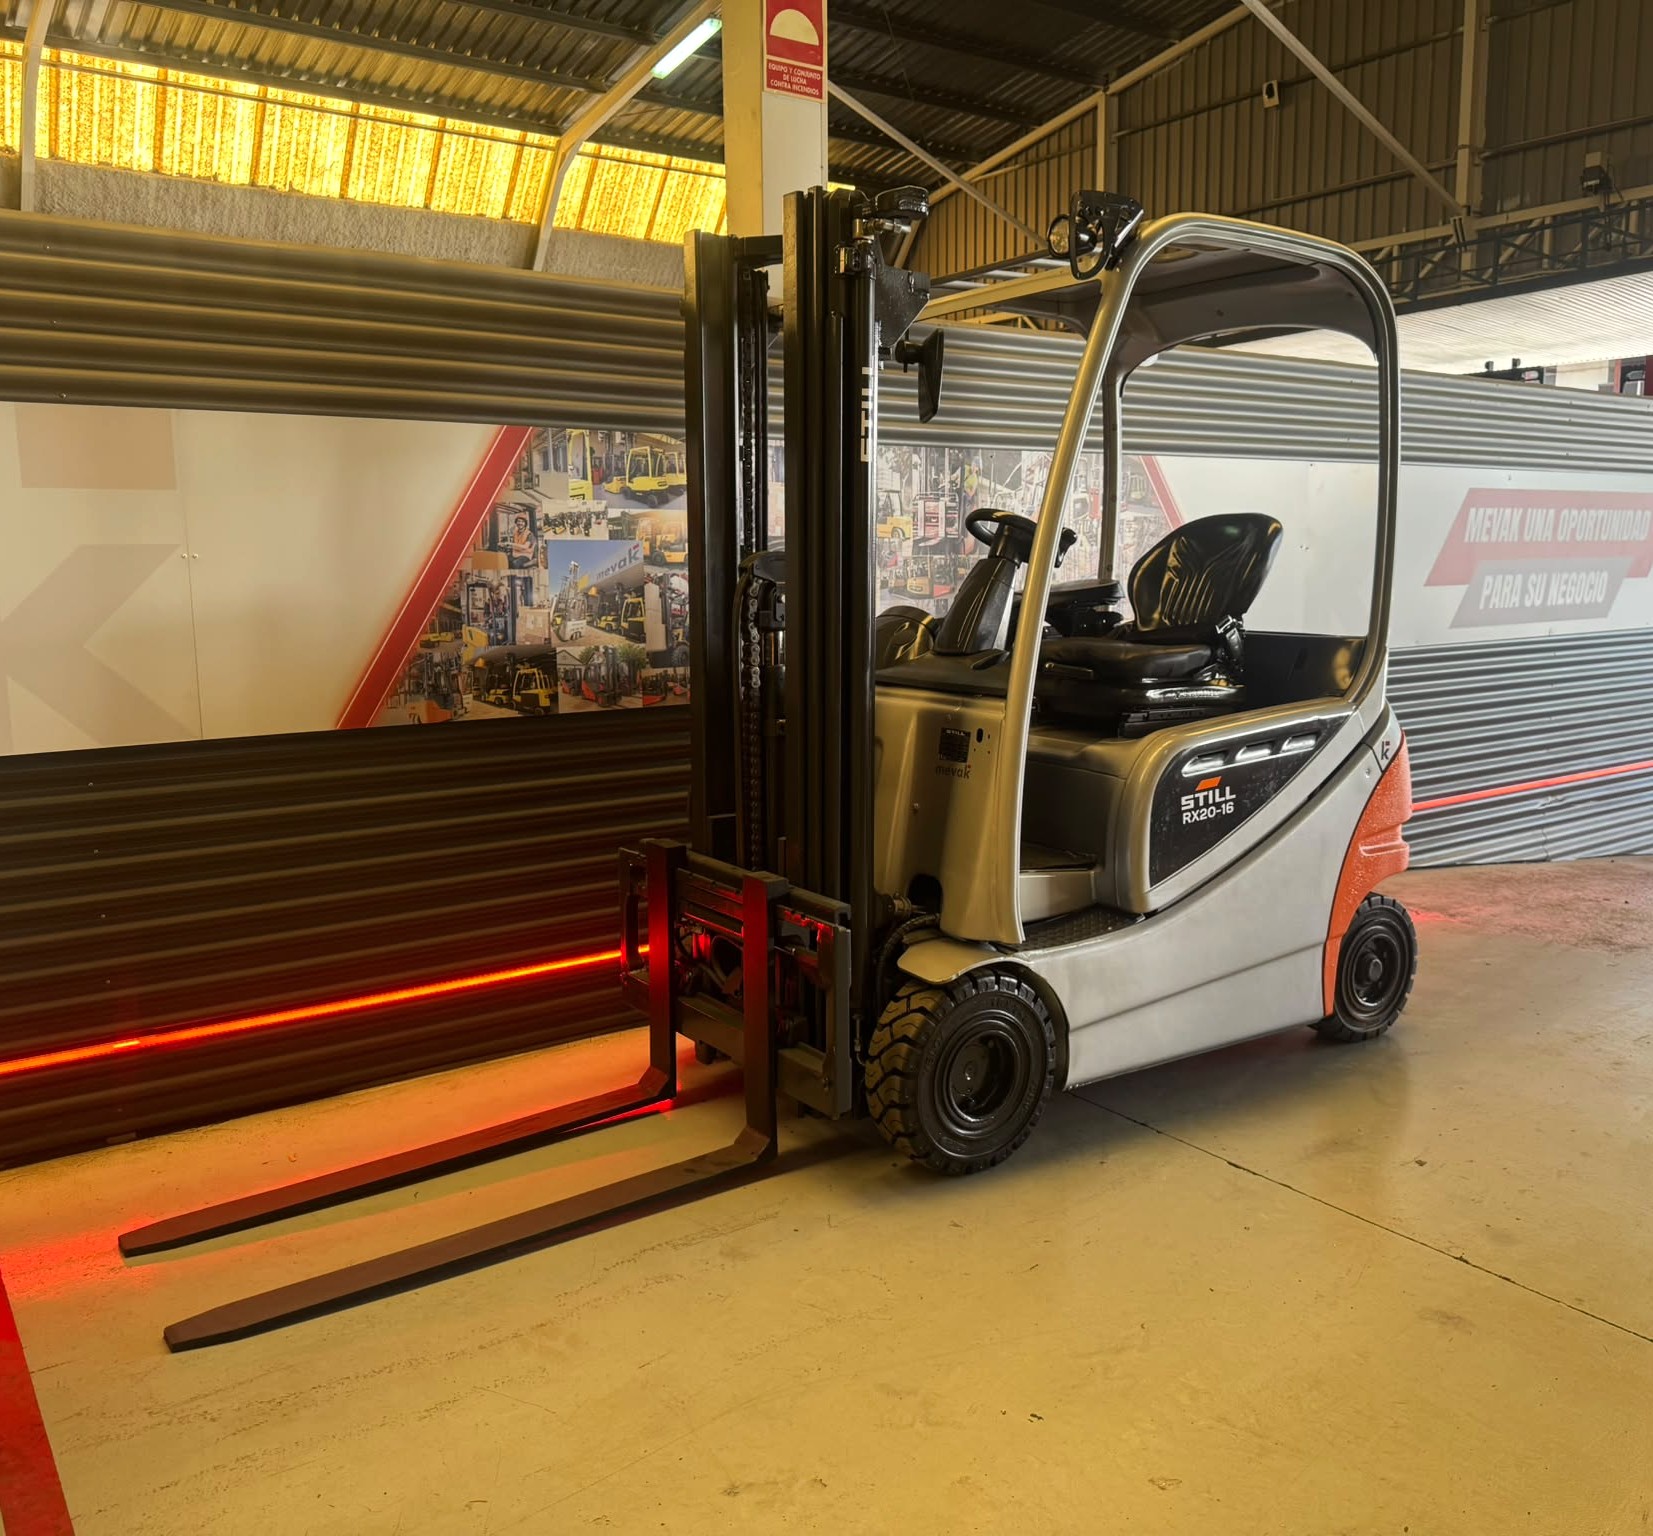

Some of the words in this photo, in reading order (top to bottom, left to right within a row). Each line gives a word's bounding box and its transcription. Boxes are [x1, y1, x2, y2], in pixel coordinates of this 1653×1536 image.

[768, 62, 788, 73] EQUIPO
[794, 68, 821, 80] CONJUNTO
[782, 73, 789, 82] DE
[790, 75, 807, 85] LUCHA
[770, 79, 791, 90] CONTRA
[792, 83, 819, 96] INCENDIOS
[1464, 507, 1523, 543] MEVAK
[1523, 508, 1555, 542] UNA
[1557, 508, 1651, 542] OPORTUNIDAD
[1479, 574, 1523, 610] PARA
[1524, 572, 1548, 607] SU
[1548, 570, 1608, 606] NEGOCIO
[1181, 786, 1236, 810] STILL
[1183, 802, 1234, 824] RX20-16
